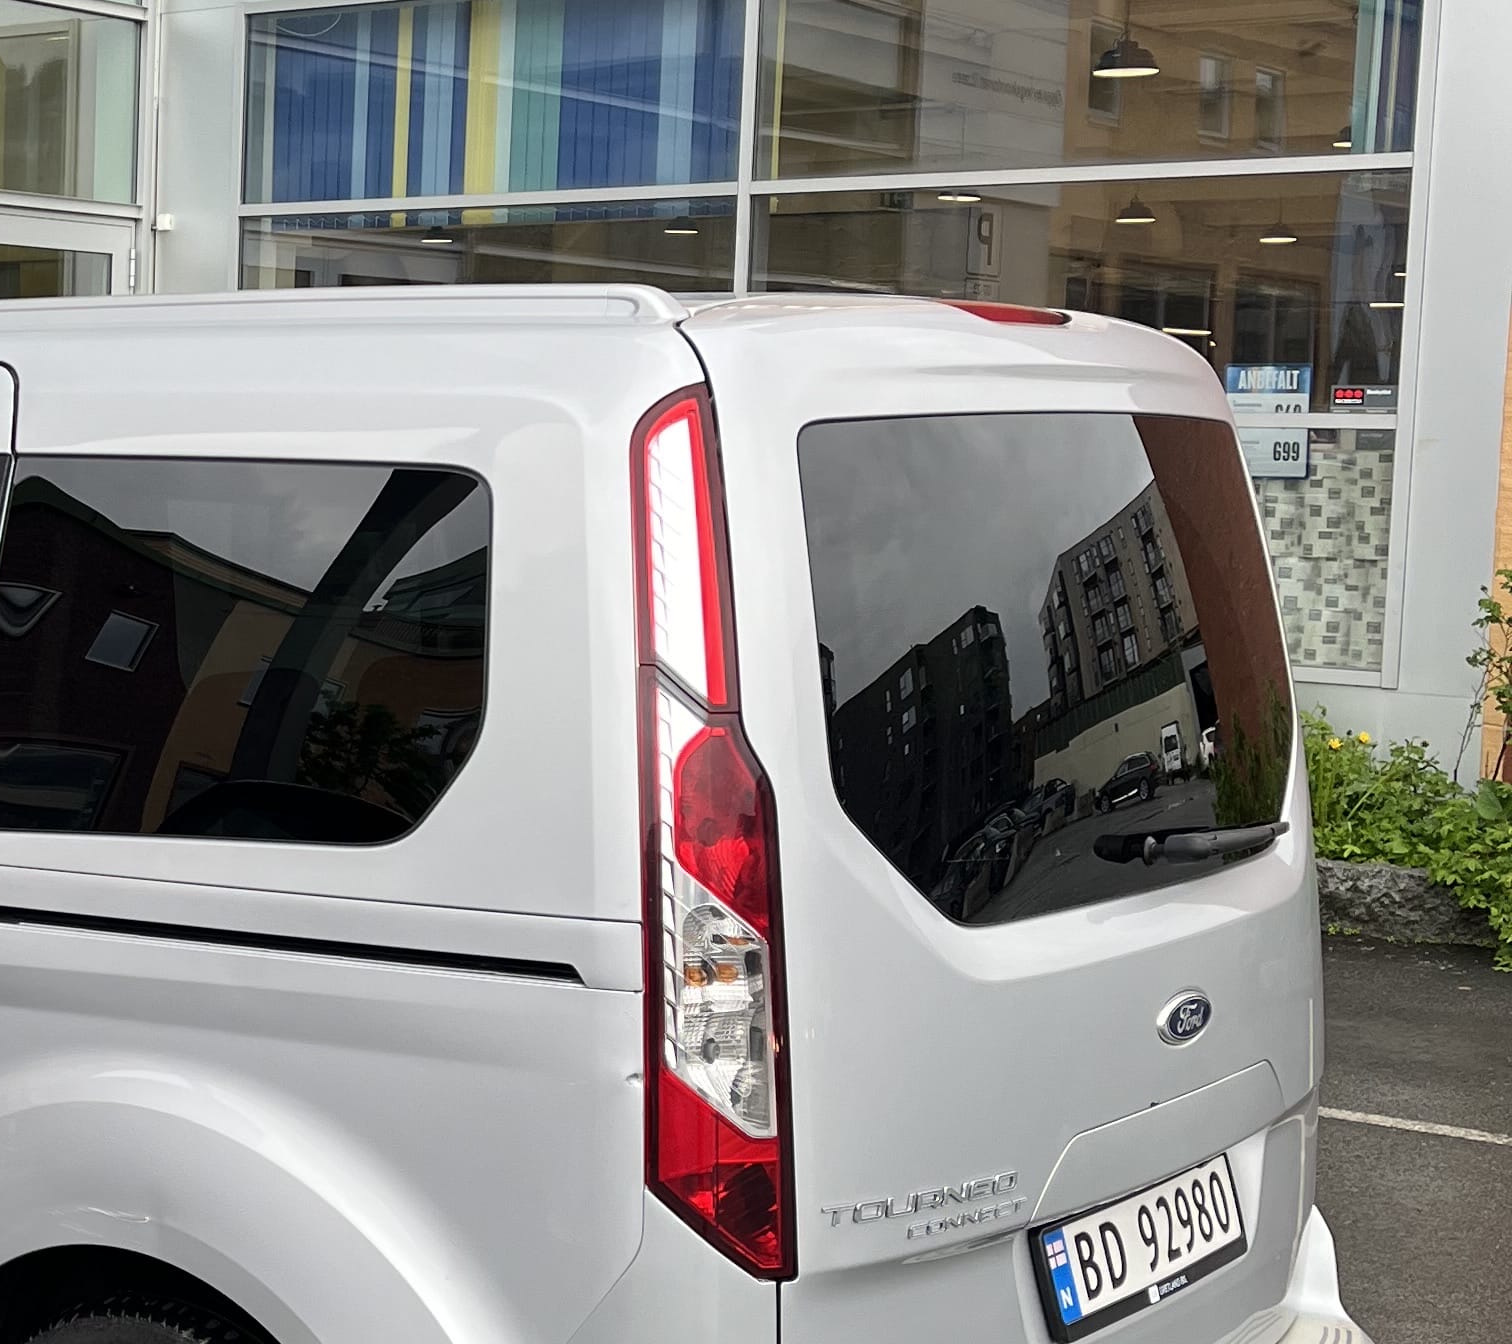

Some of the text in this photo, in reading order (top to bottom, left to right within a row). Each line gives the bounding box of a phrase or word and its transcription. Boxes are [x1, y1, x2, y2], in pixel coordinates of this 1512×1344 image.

[1272, 441, 1301, 462] 699
[1177, 1002, 1204, 1034] Ford
[820, 1170, 1018, 1228] TOURNEO
[906, 1196, 1028, 1240] CONNECT
[1074, 1170, 1230, 1301] BD 92980
[1059, 1286, 1074, 1309] N
